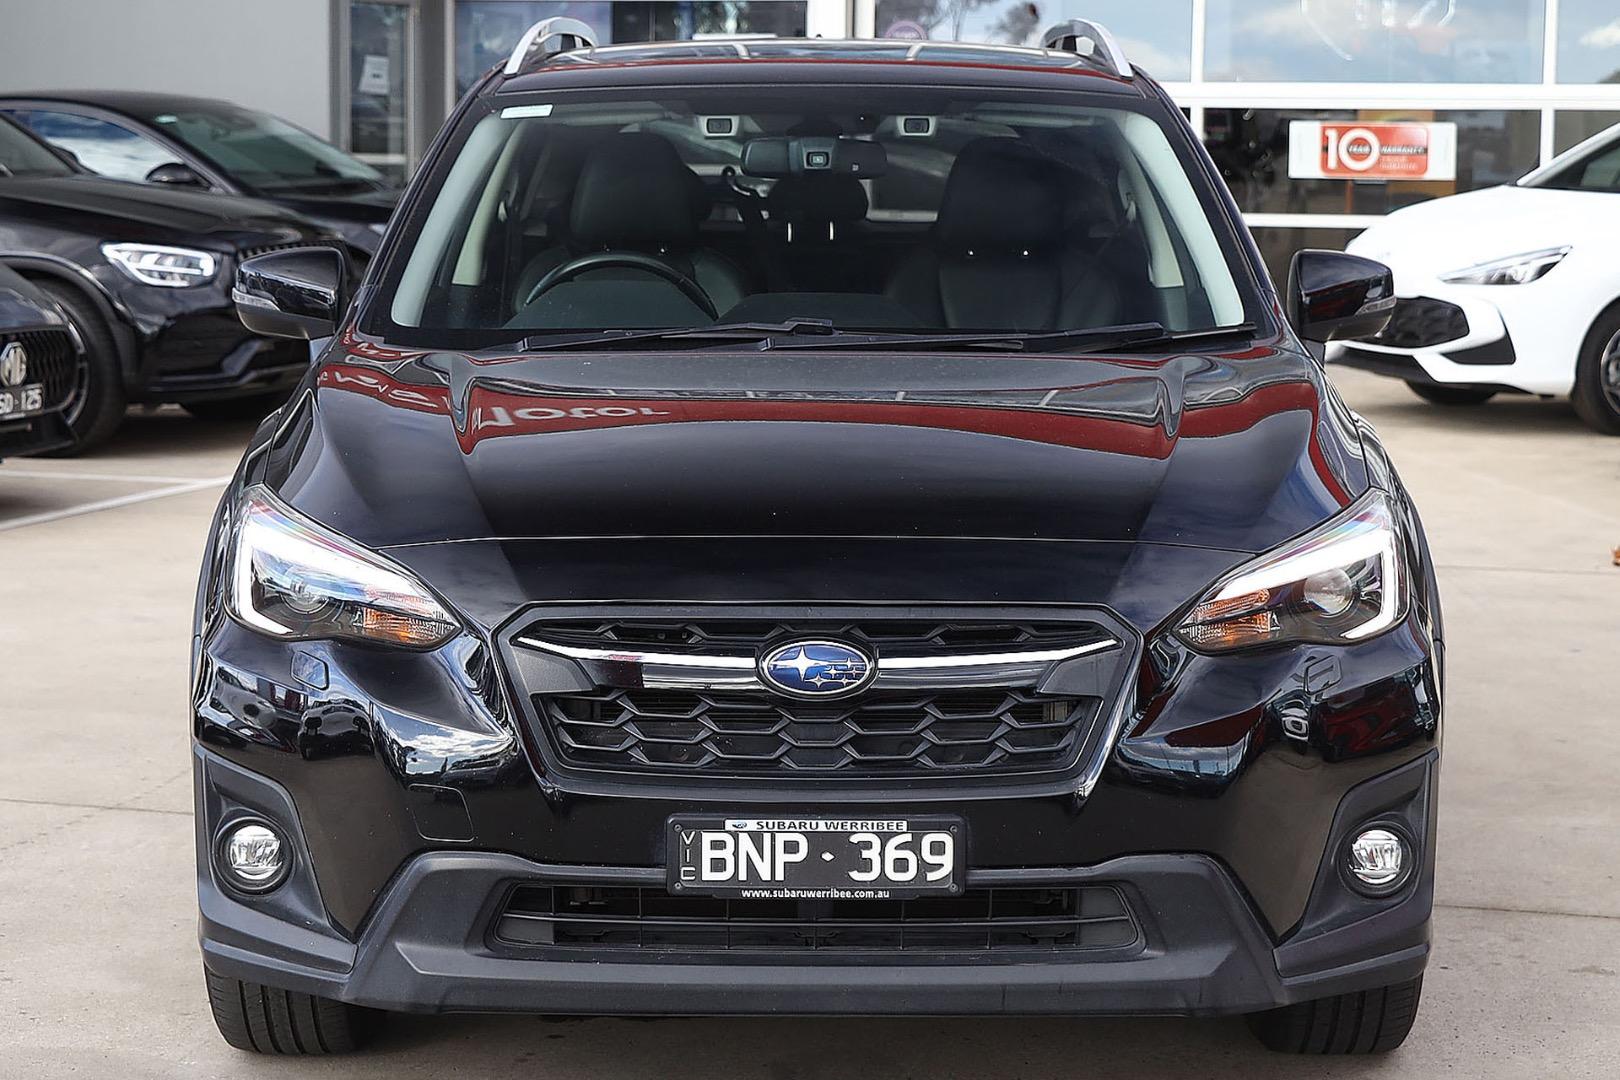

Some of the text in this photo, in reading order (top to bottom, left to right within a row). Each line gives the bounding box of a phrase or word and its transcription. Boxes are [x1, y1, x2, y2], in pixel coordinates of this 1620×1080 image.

[1325, 128, 1380, 171] 10
[756, 821, 904, 831] SUBARU WERRIBEE
[680, 831, 696, 881] VIC
[701, 832, 954, 882] BNP 369
[741, 888, 890, 899] www.subaruwerribee.com.au
